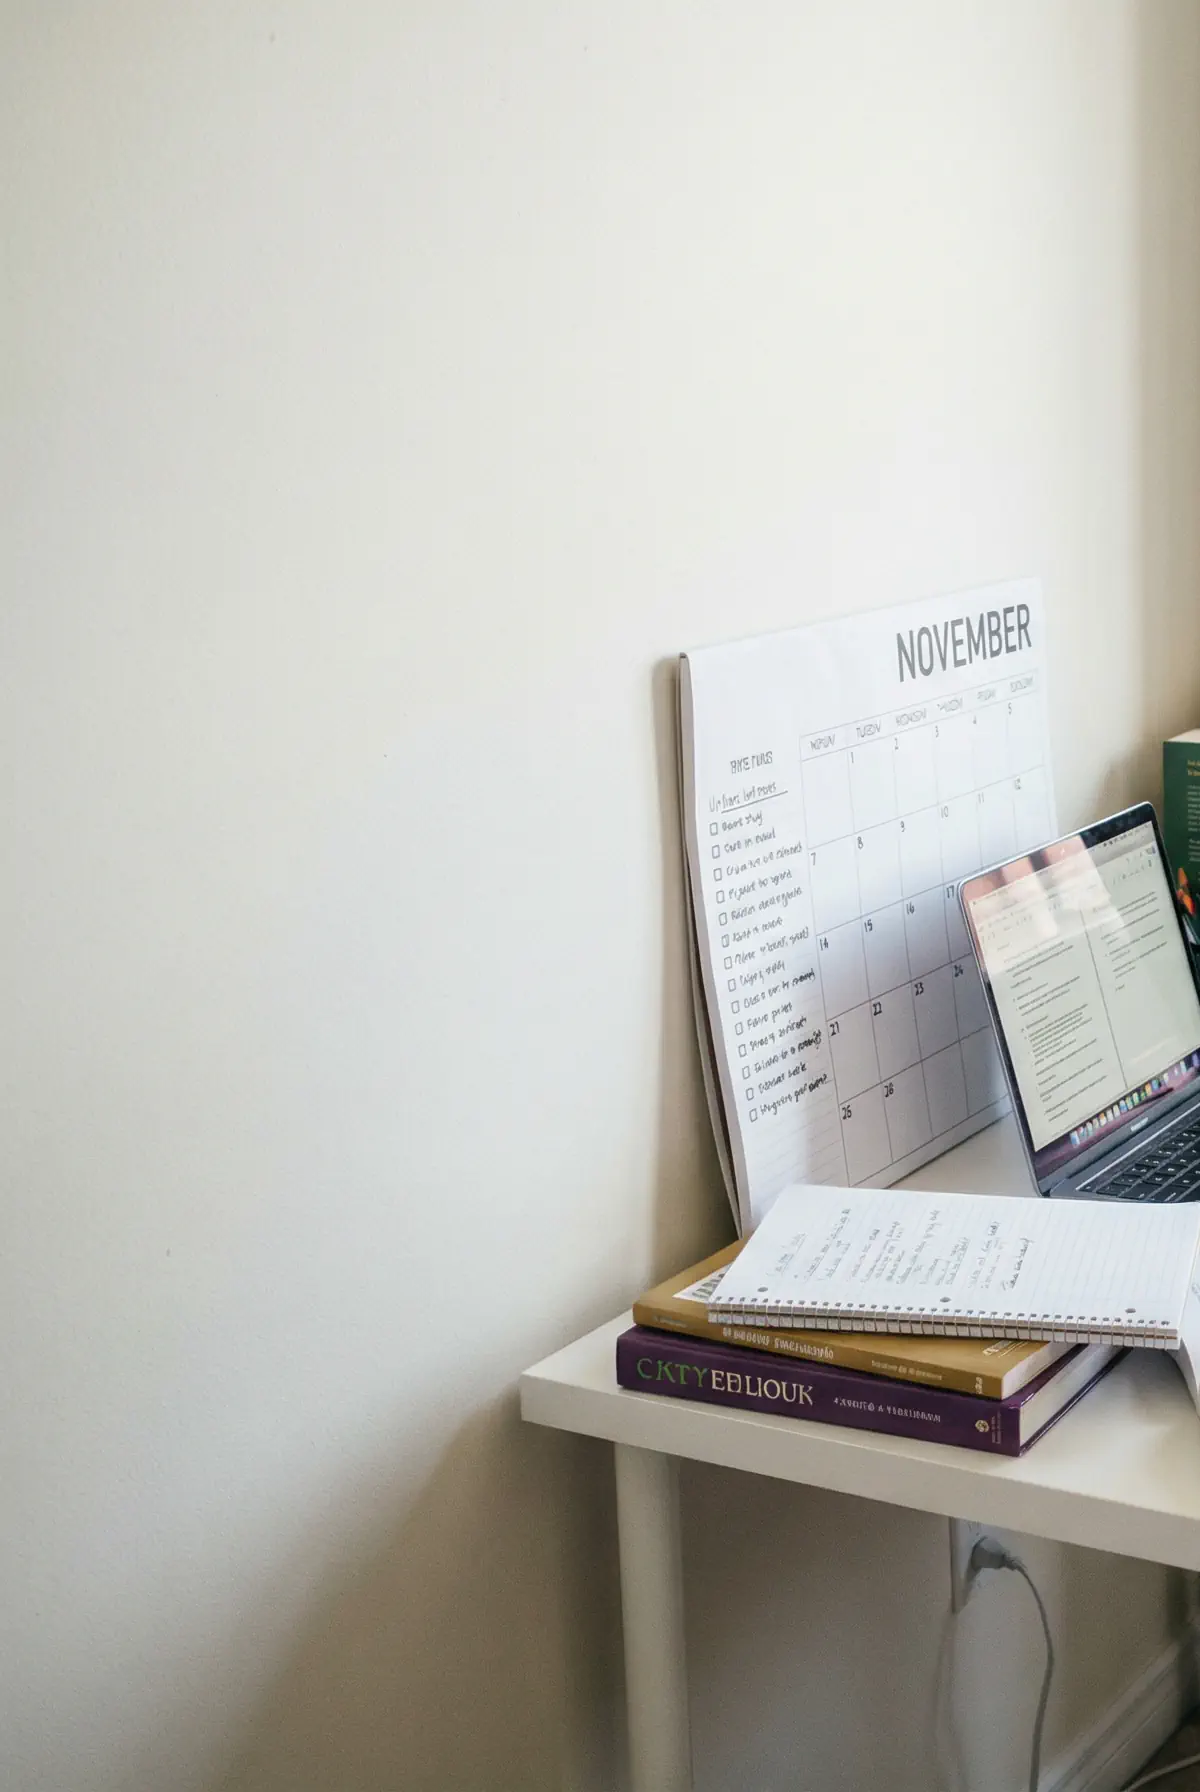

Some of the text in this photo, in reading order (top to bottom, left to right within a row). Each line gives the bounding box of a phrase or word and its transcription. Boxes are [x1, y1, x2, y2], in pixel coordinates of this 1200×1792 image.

[896, 603, 1032, 683] NOVEMBER
[940, 805, 949, 819] 10
[857, 836, 864, 850] 8
[810, 851, 816, 866] 7
[946, 885, 955, 899] 17
[906, 901, 915, 915] 16
[864, 919, 873, 933] 15
[820, 937, 829, 951] 14
[914, 982, 924, 997] 23
[872, 1002, 882, 1017] 22
[829, 1021, 840, 1037] 21
